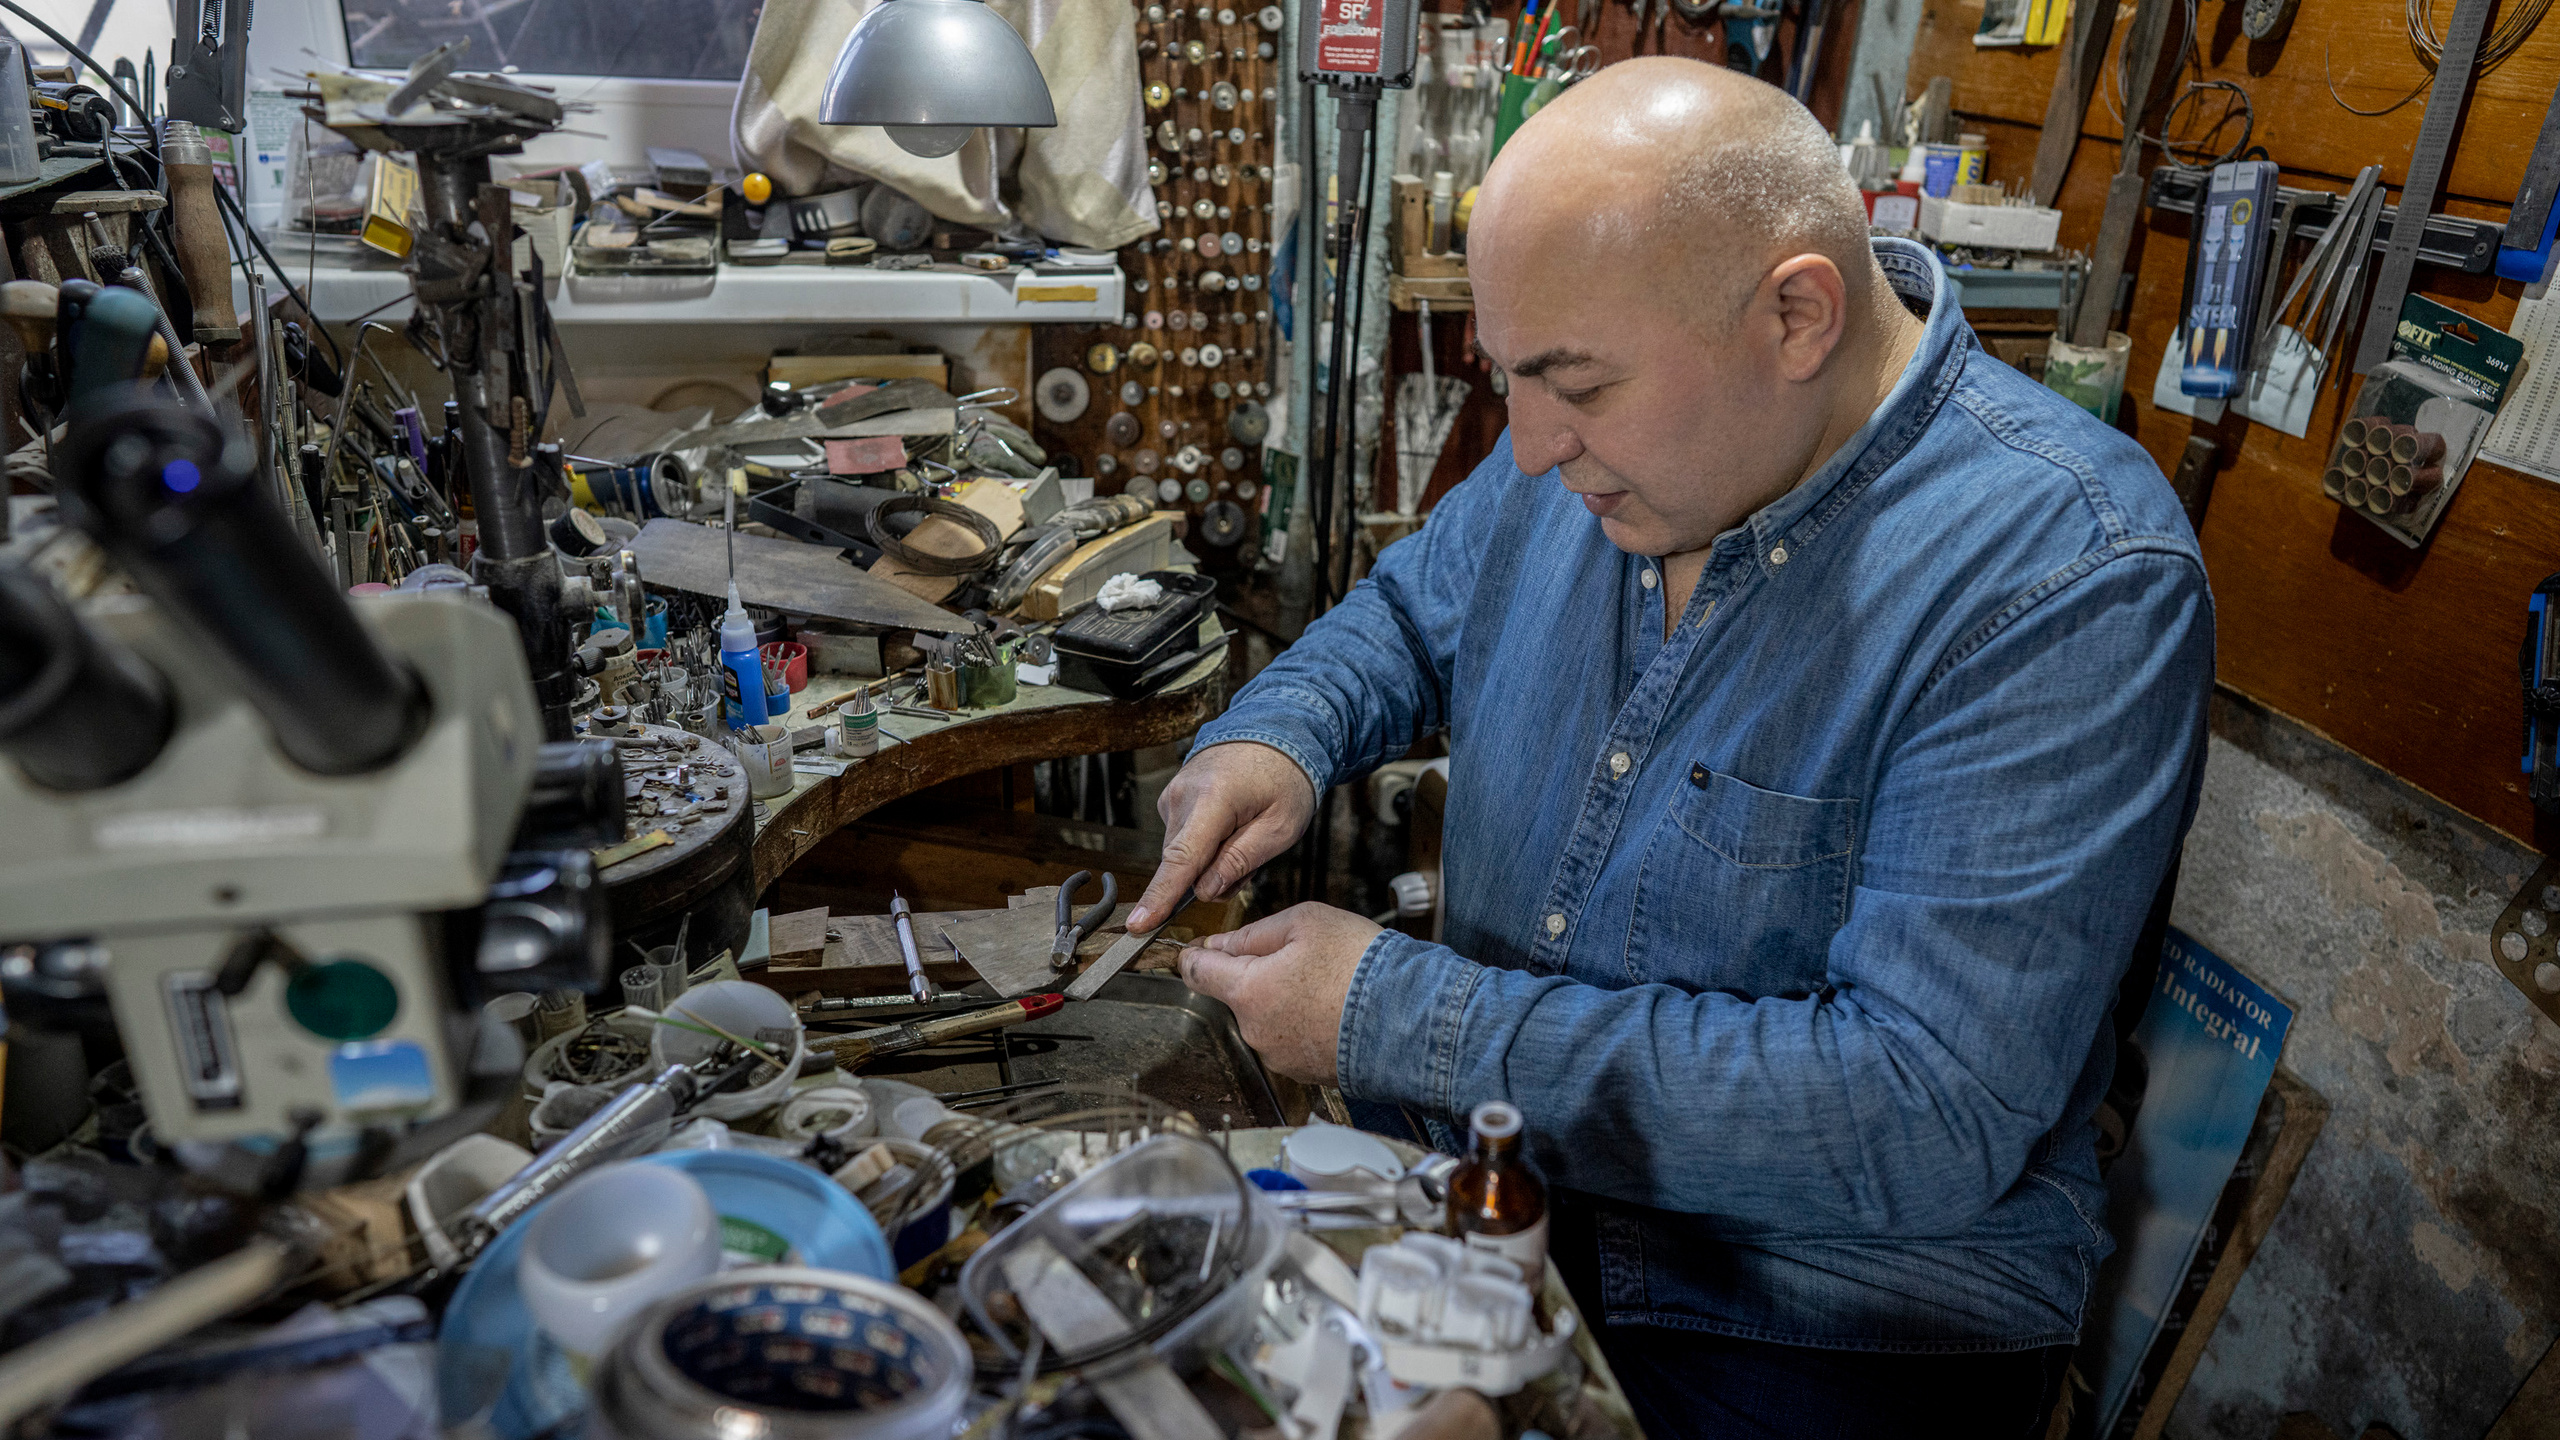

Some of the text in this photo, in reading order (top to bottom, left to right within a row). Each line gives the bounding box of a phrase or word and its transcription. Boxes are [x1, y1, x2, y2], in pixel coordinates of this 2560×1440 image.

[2420, 354, 2456, 376] SANDING
[2456, 370, 2481, 387] BAND
[2480, 383, 2499, 396] SET
[2485, 355, 2510, 373] 36914
[2163, 971, 2261, 1061] Integral
[2184, 954, 2273, 1031] RADIATOR
